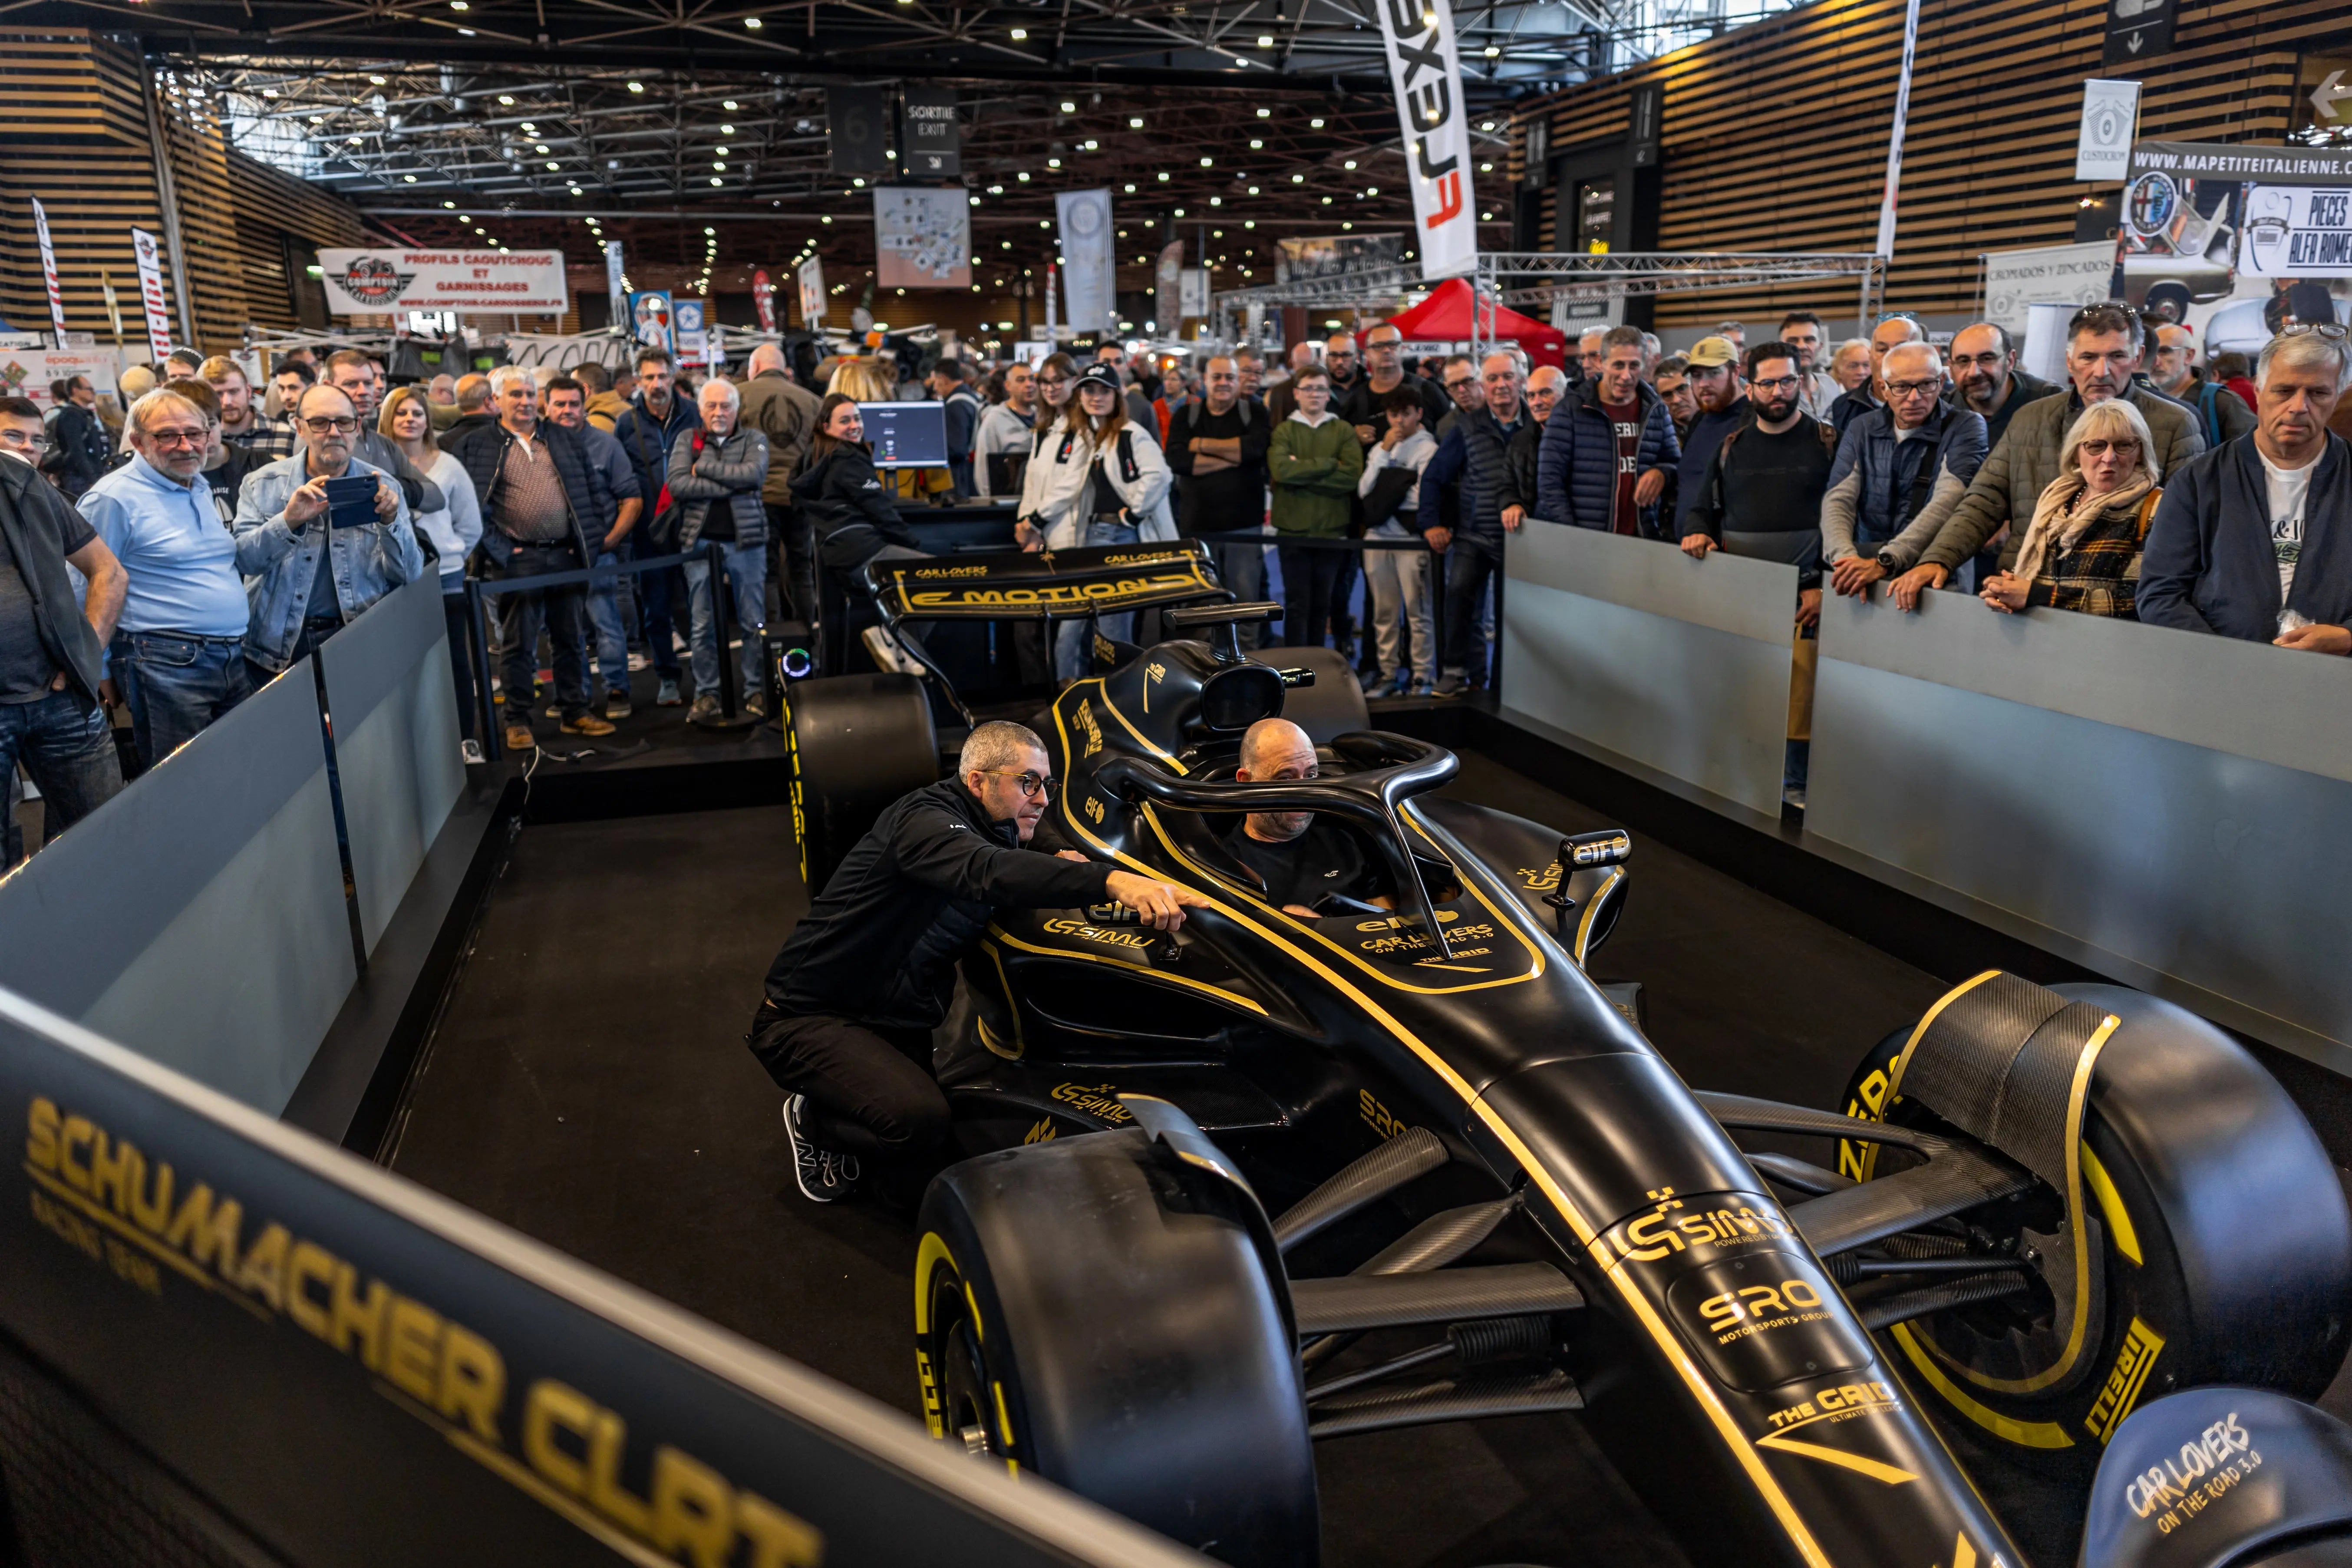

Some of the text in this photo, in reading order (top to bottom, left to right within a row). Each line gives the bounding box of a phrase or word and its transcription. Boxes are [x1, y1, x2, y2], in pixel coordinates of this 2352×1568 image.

[908, 106, 955, 119] SORTIE
[917, 123, 947, 136] EXIT
[2308, 195, 2349, 226] PIECES
[2289, 233, 2352, 263] ALFA ROME
[404, 254, 553, 265] PROFILS CAOUTCHOUC
[473, 269, 489, 278] ET
[436, 282, 528, 292] GARNISSAGES
[1104, 551, 1173, 563] CAR LOVERS
[943, 566, 988, 574] LOVERS
[1360, 937, 1411, 950] CAR
[1714, 1234, 1758, 1248] POWERED
[26, 1096, 505, 1449] SCHUMACHER
[1699, 1279, 1822, 1333] SRO
[1718, 1311, 1834, 1344] MOTORSPORTS GROUP
[1766, 1401, 1816, 1428] THE
[2127, 1412, 2250, 1517] CAR LOVERS
[2157, 1514, 2182, 1534] ON
[2177, 1491, 2208, 1518] THE
[2205, 1466, 2241, 1498] ROAD
